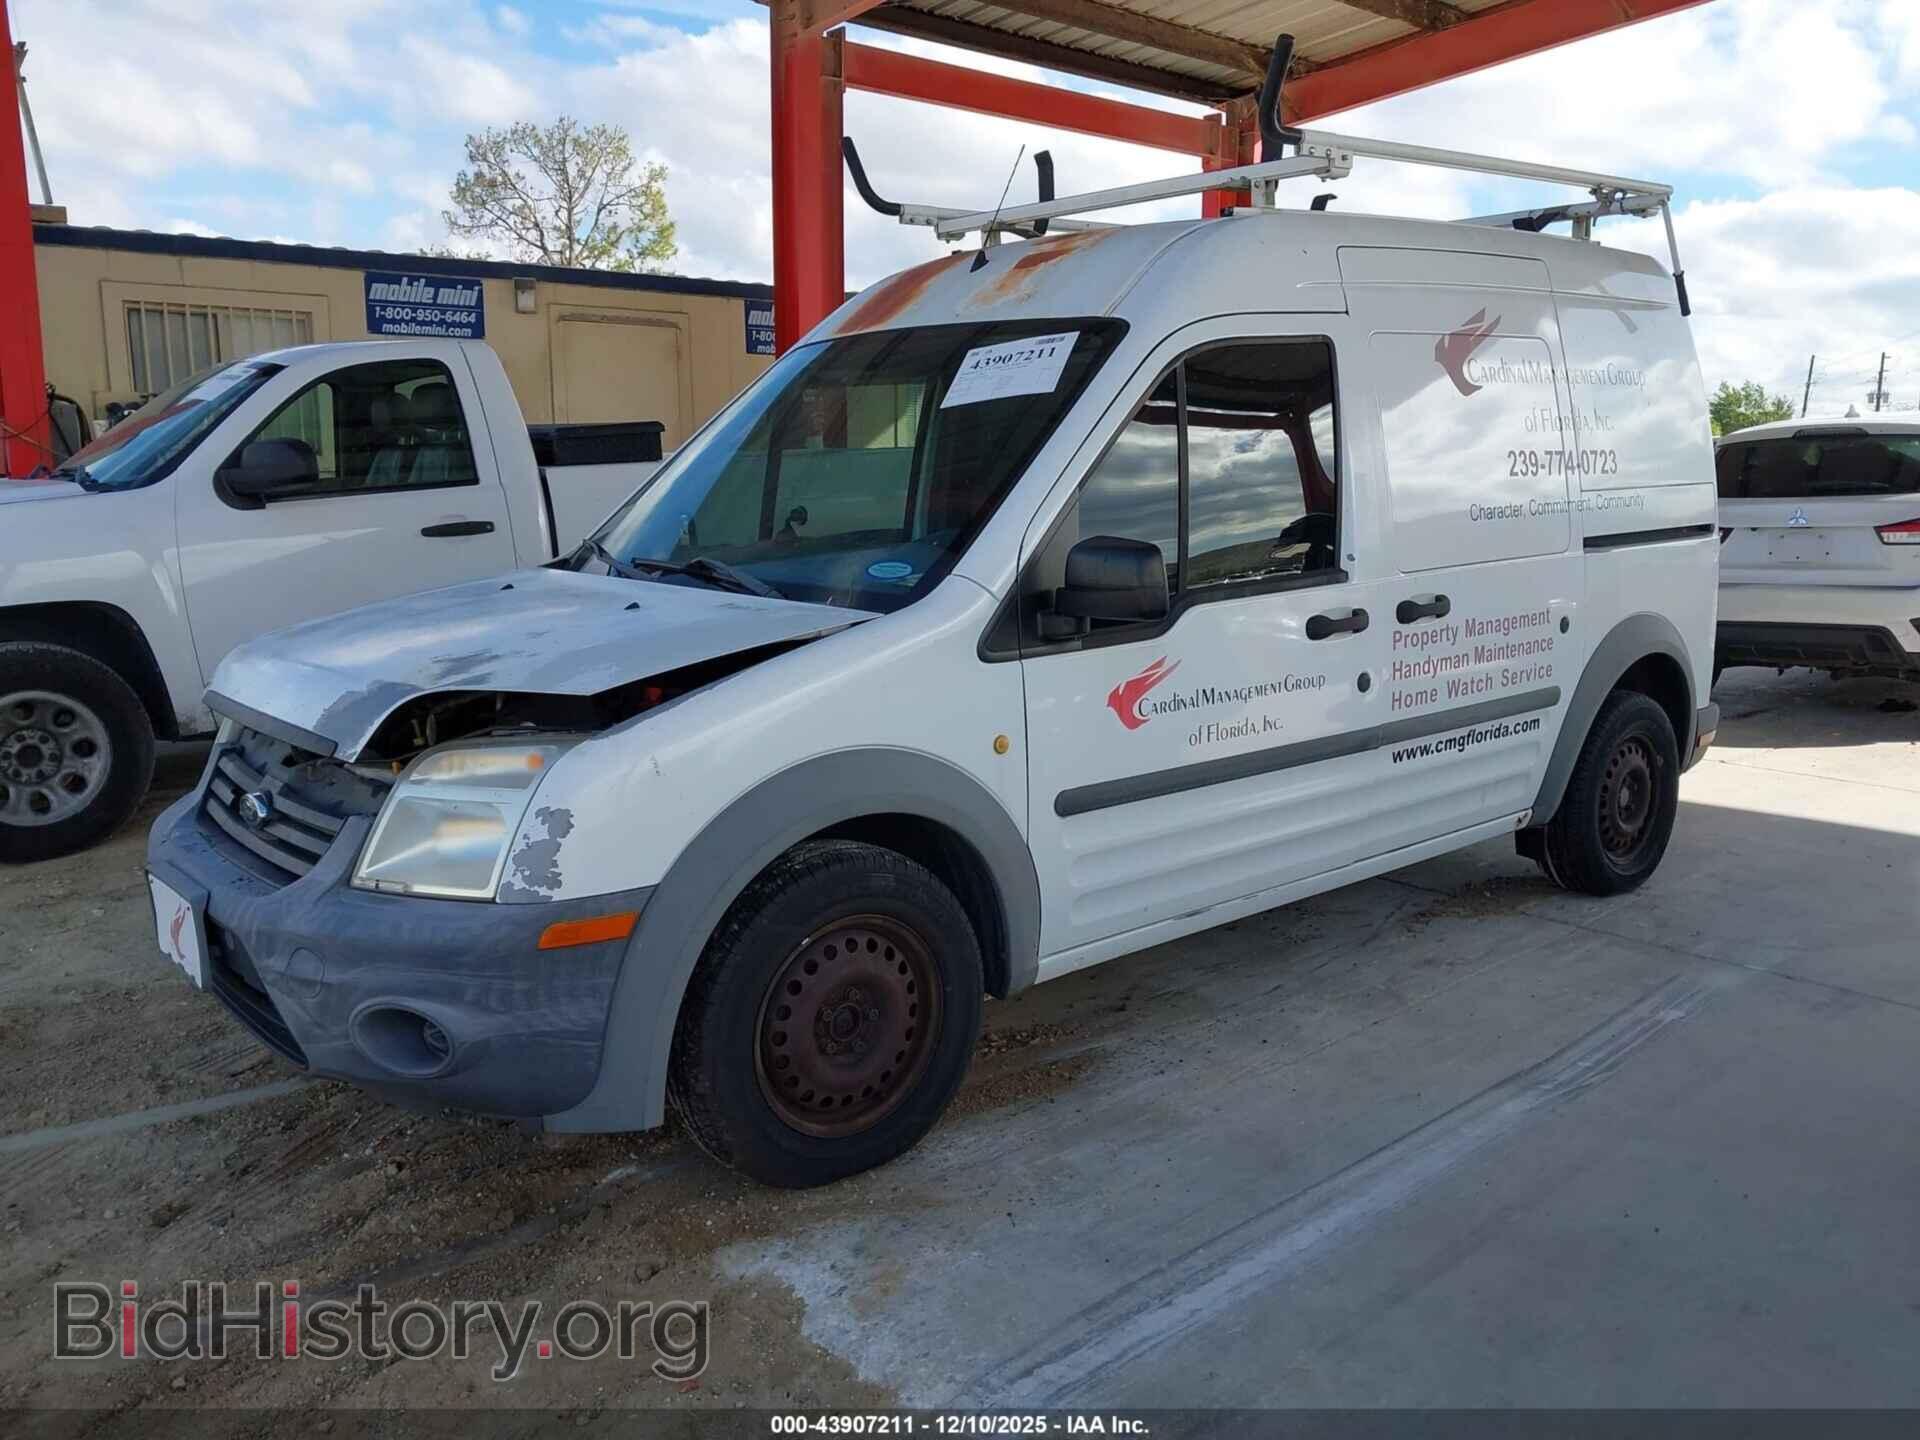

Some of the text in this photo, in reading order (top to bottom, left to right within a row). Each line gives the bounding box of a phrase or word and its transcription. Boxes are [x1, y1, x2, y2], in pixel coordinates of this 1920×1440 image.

[369, 277, 480, 306] mobile mini
[375, 306, 476, 324] 1-800-950-6464
[382, 322, 472, 337] mobilemini.com
[971, 347, 1056, 370] 43907211
[1524, 407, 1538, 433] of
[1507, 449, 1618, 477] 239-774-0723
[1470, 492, 1646, 521] Character, Commitment, Community
[1392, 607, 1552, 651] Property Management
[1392, 636, 1554, 681] Handyman Maintenance
[1391, 662, 1553, 711] Home Watch Service
[1189, 725, 1203, 746] of
[1392, 717, 1540, 763] www.cmgflorida.com
